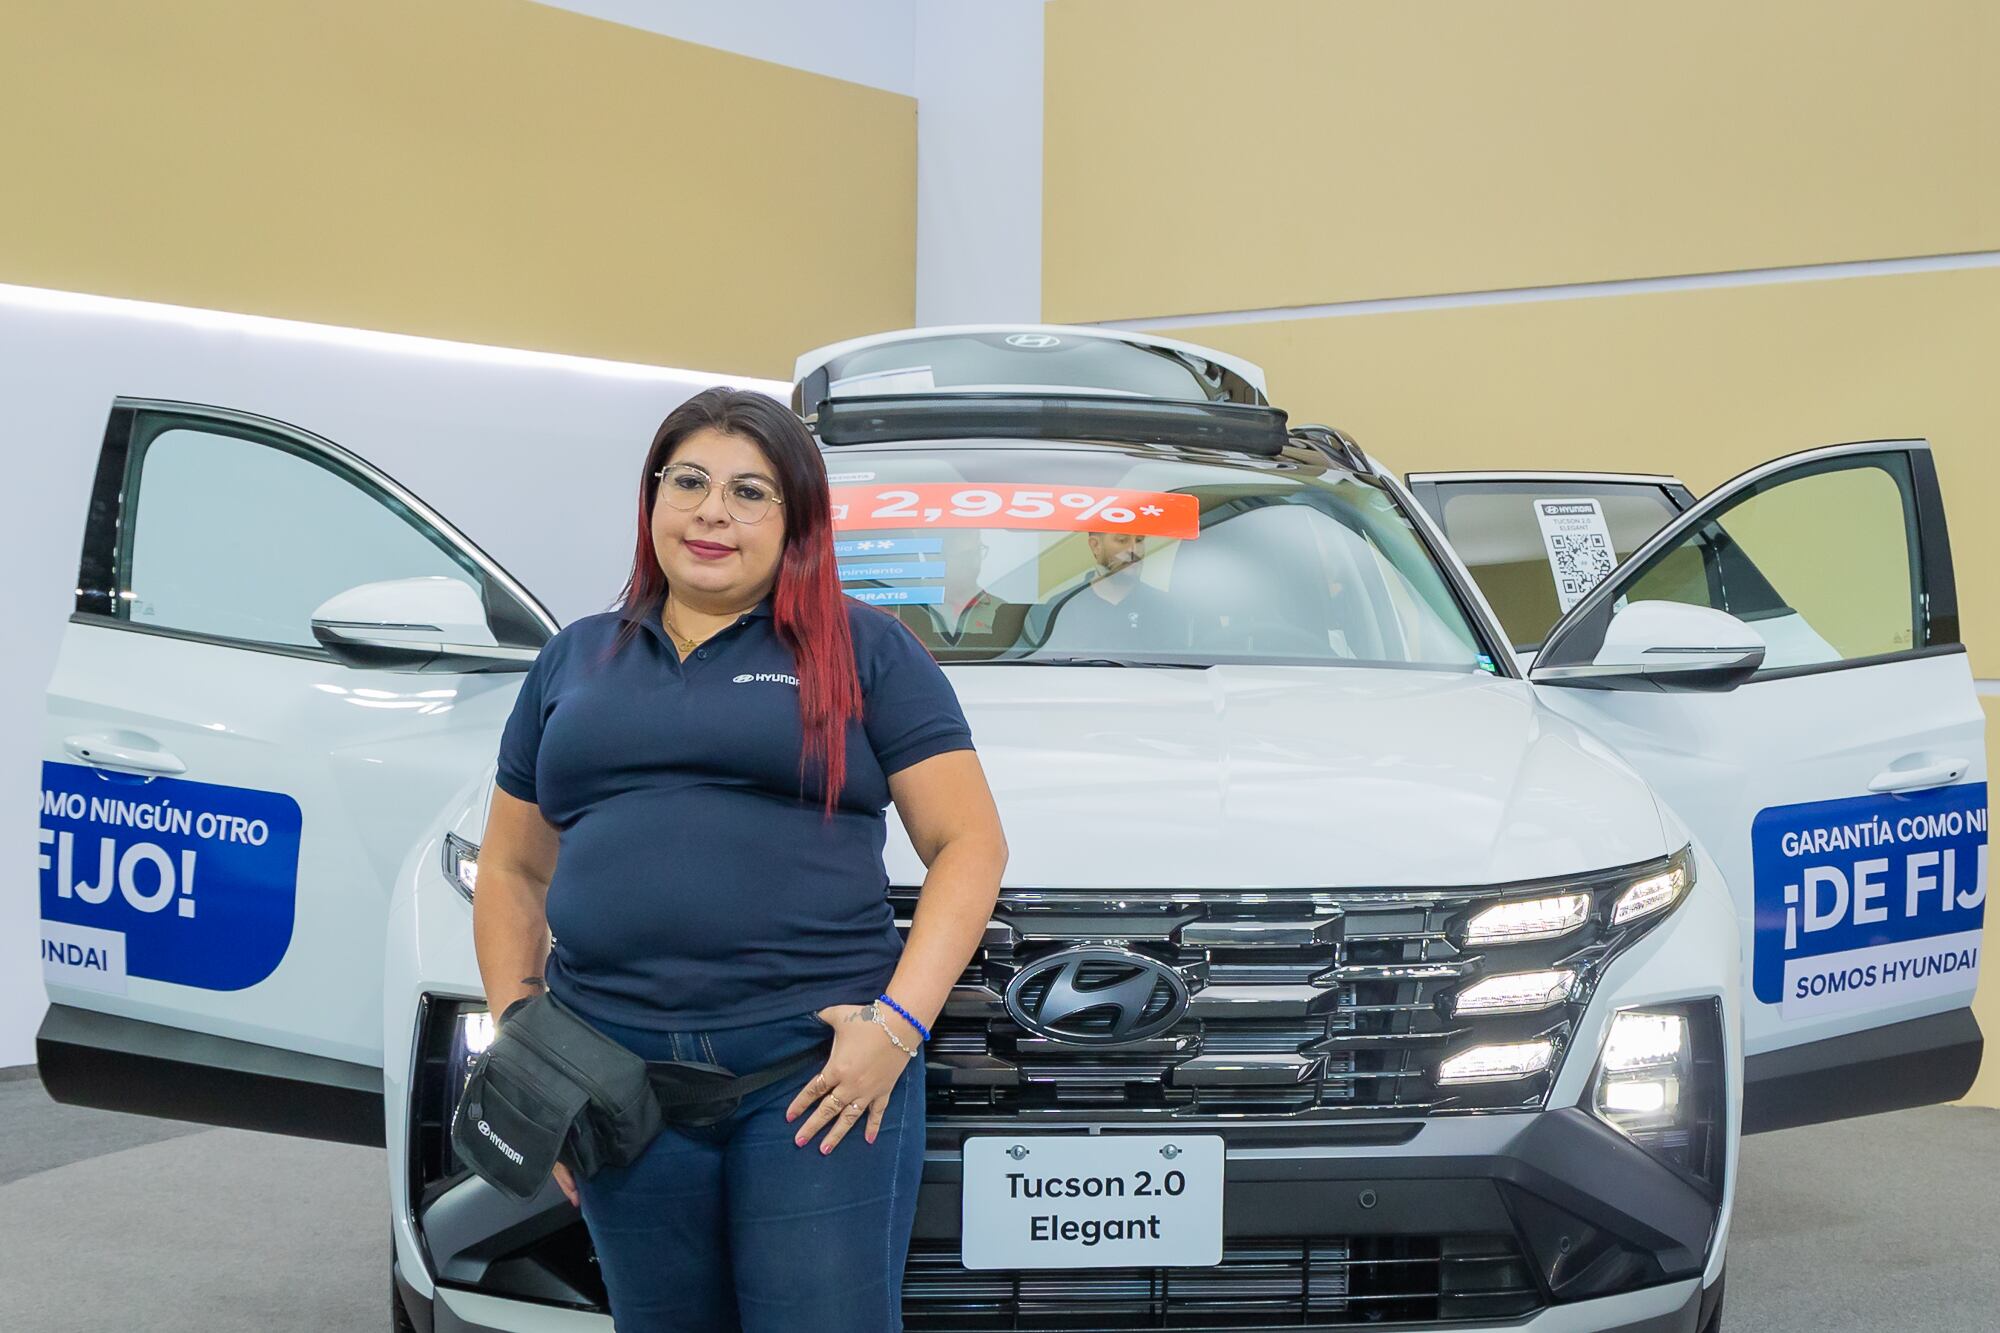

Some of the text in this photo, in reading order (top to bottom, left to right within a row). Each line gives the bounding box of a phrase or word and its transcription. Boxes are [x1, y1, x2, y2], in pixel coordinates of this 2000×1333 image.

[1559, 505, 1592, 514] HYUNDAI
[837, 567, 903, 577] nimiento
[855, 591, 908, 601] GRATIS
[90, 797, 193, 836] NINGÚN
[196, 812, 269, 846] OTRO
[1781, 808, 1987, 858] GARANTÍA COMO NI
[1784, 857, 1889, 951] ¡DE
[41, 938, 108, 972] NDAI
[1795, 948, 1977, 999] SOMOS HYUNDAI
[489, 1131, 524, 1166] HYUNDAI
[1005, 1170, 1186, 1198] Tucson 2.0
[1030, 1214, 1161, 1247] Elegant
